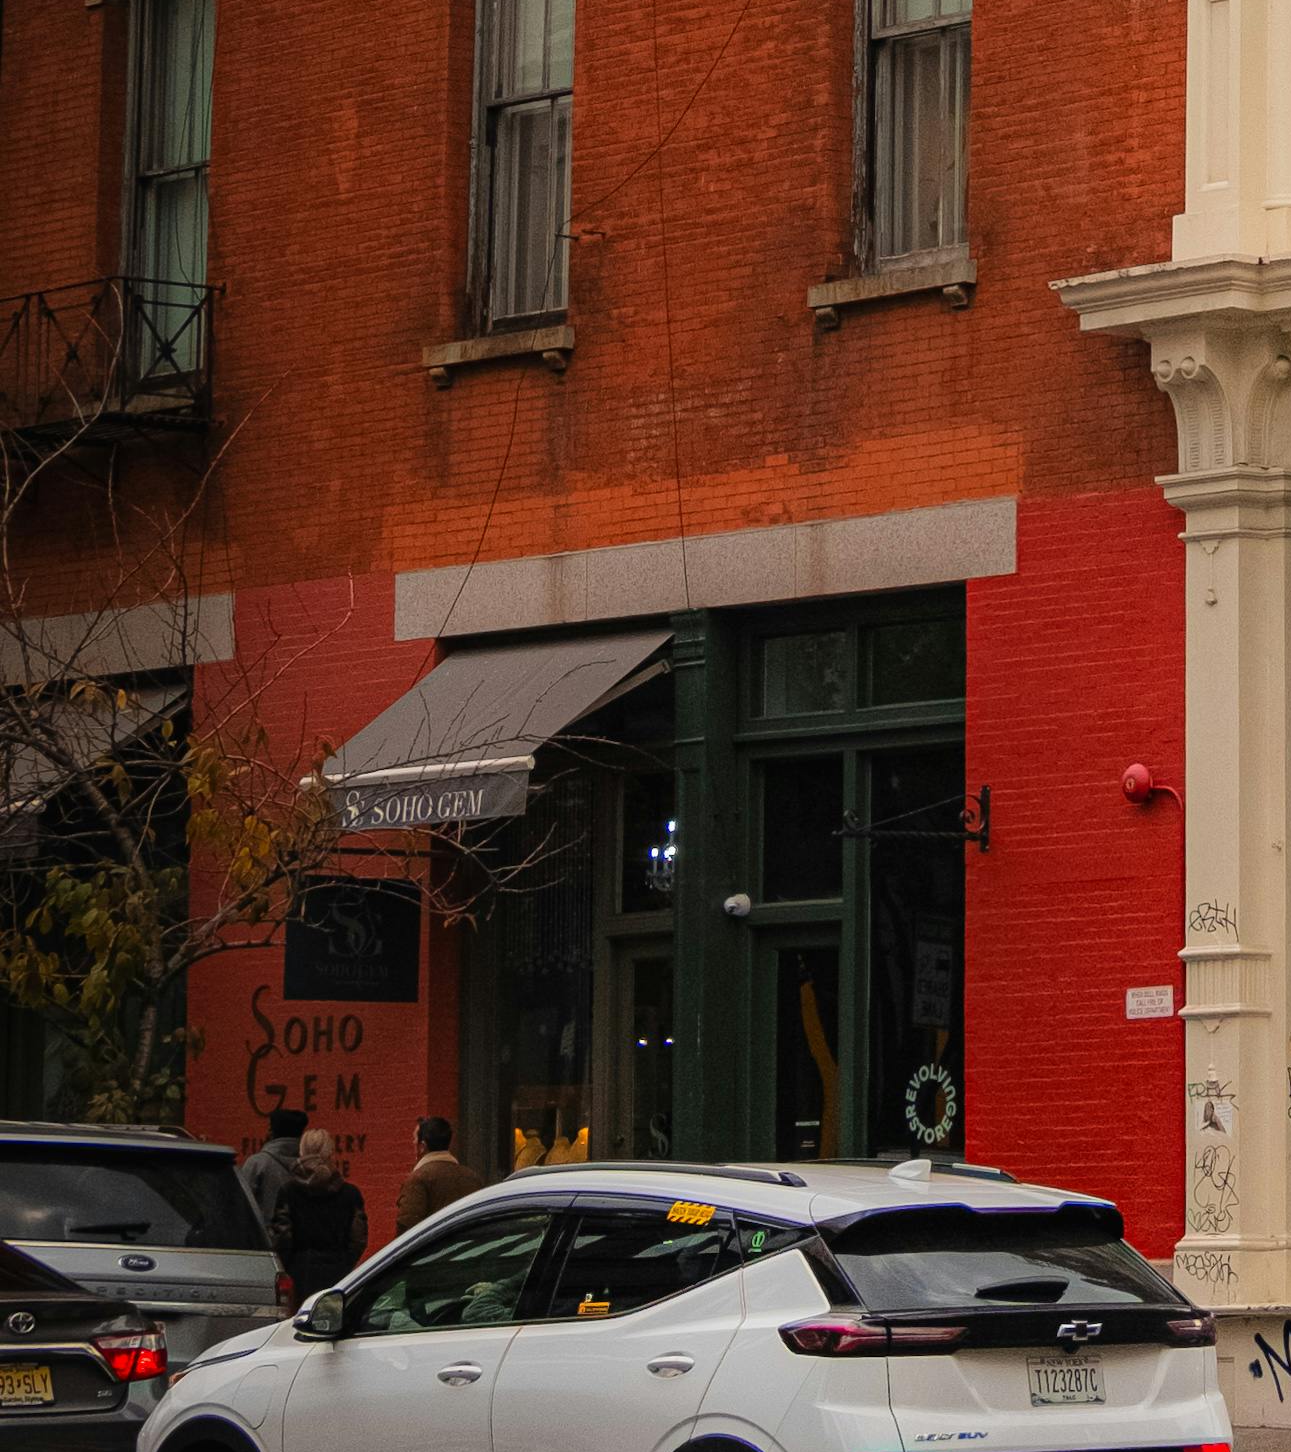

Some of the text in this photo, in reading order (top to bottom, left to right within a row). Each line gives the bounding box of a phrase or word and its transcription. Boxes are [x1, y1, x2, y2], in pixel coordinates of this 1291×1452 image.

[370, 789, 485, 825] SOHO GEM
[251, 984, 364, 1058] SOHO
[905, 1063, 957, 1118] REVOLVING
[908, 1116, 953, 1144] STORE
[1045, 1357, 1086, 1367] NEW YORK
[24, 1374, 49, 1394] SLY
[1034, 1368, 1098, 1394] T123287C
